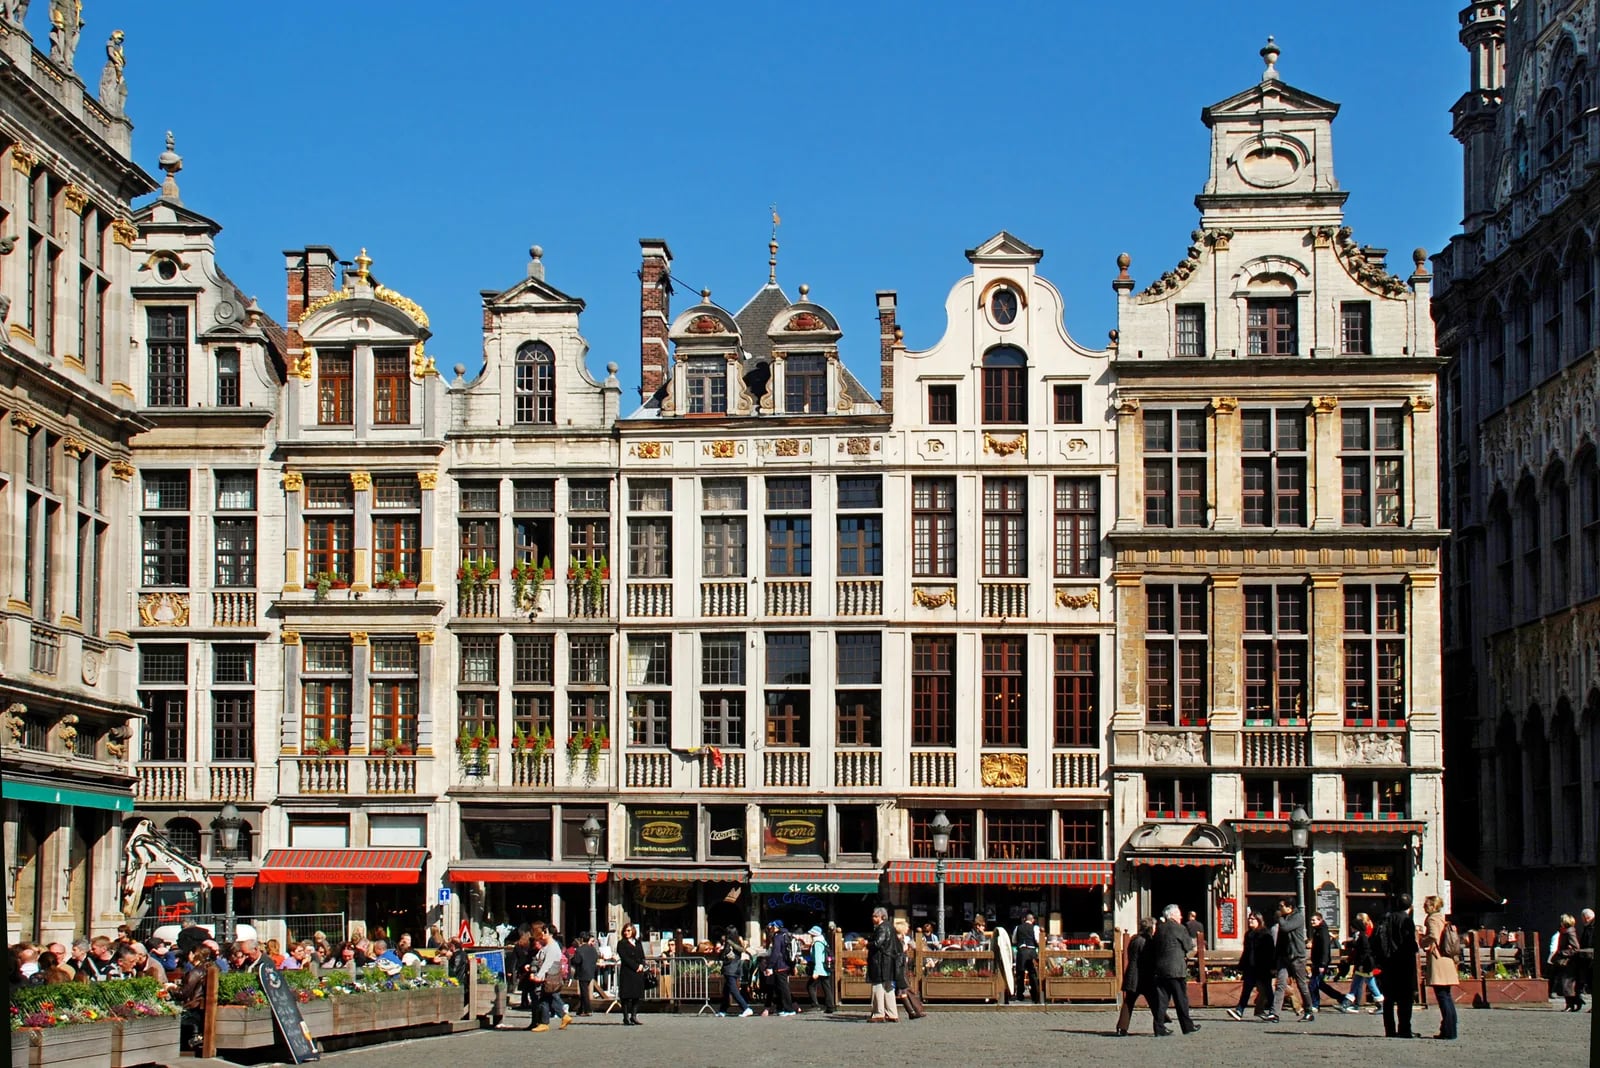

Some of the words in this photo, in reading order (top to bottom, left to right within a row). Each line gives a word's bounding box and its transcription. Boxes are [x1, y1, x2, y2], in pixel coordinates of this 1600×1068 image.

[642, 826, 682, 838] aroma
[775, 826, 816, 837] aroma
[787, 884, 800, 892] EL
[805, 884, 839, 892] GRECO
[767, 897, 779, 908] EL
[782, 893, 824, 910] GRECO
